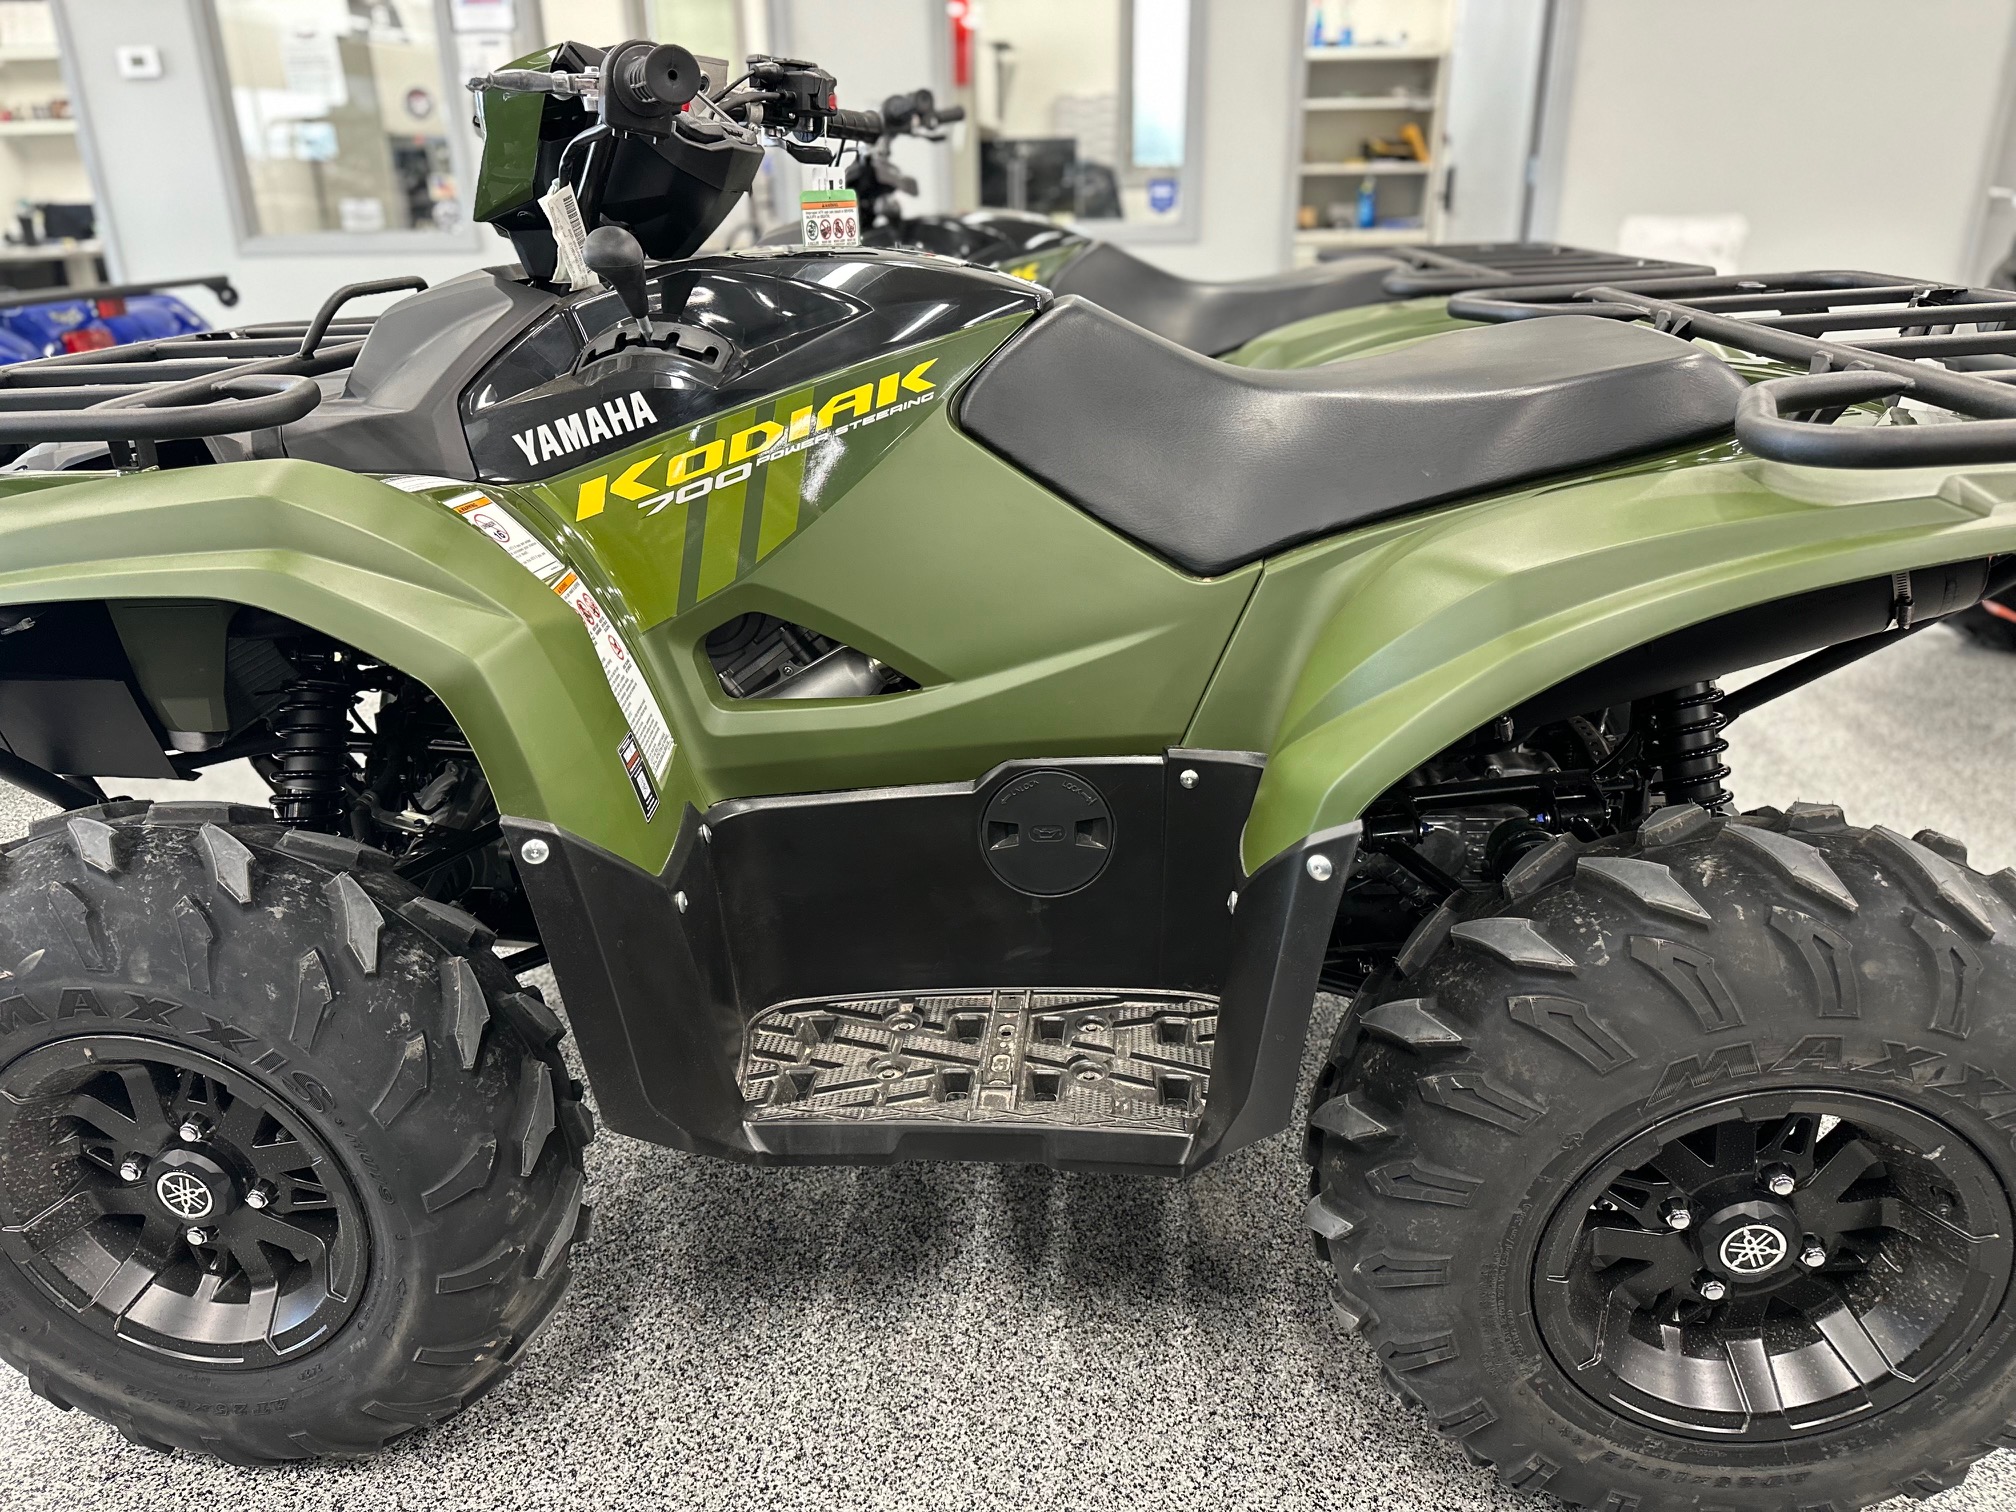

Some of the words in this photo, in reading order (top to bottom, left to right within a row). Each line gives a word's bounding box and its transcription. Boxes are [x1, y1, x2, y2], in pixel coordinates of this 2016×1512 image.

[511, 391, 658, 467] YAMAHA
[575, 357, 938, 523] KODIAK
[756, 434, 831, 467] POWER
[834, 392, 935, 438] STEERING
[637, 462, 753, 518] 700
[1062, 780, 1083, 795] LOCK
[0, 987, 336, 1113] MAXXIS
